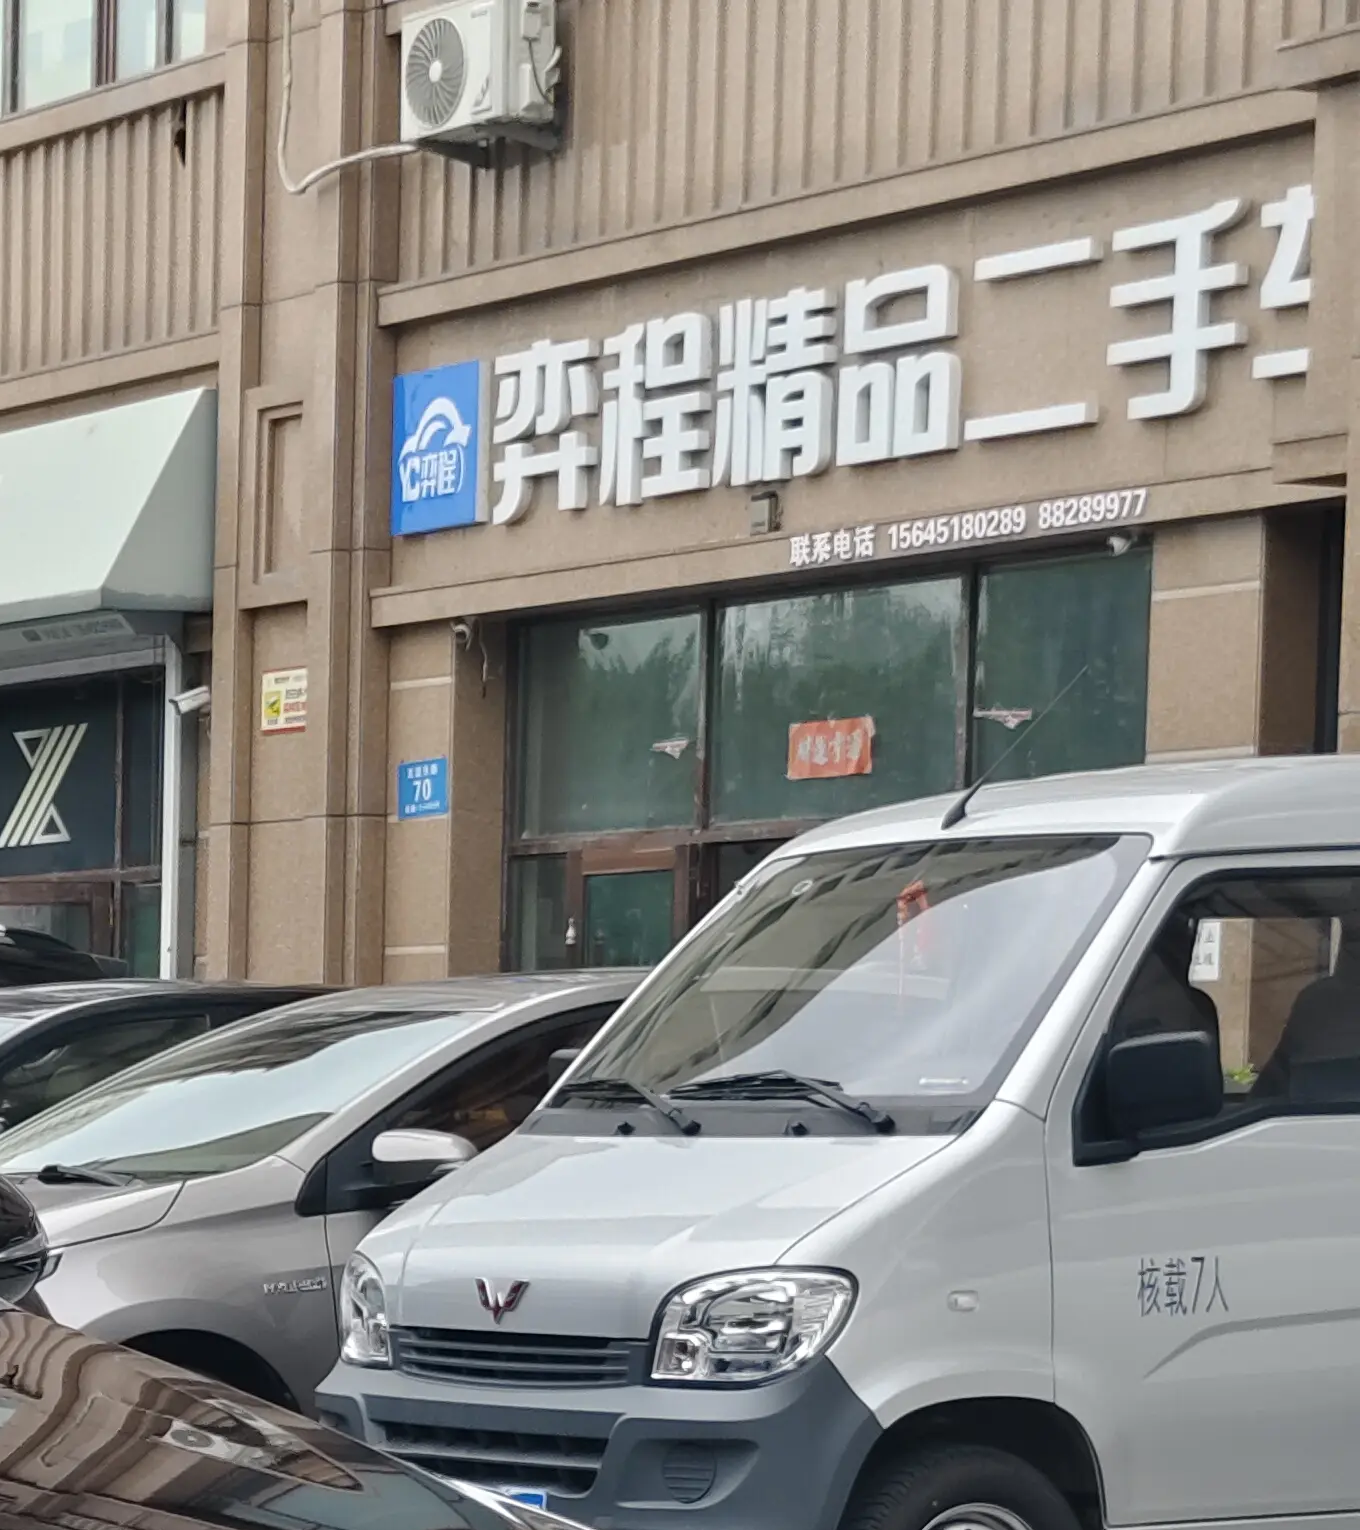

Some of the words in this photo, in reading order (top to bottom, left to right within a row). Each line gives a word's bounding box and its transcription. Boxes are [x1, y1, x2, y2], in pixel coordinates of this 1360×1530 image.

[789, 525, 876, 567] 联系电话
[888, 506, 1027, 551] 15645180289
[1038, 487, 1147, 530] 88289977
[412, 778, 432, 803] 70
[1137, 1255, 1229, 1317] 核载7人
